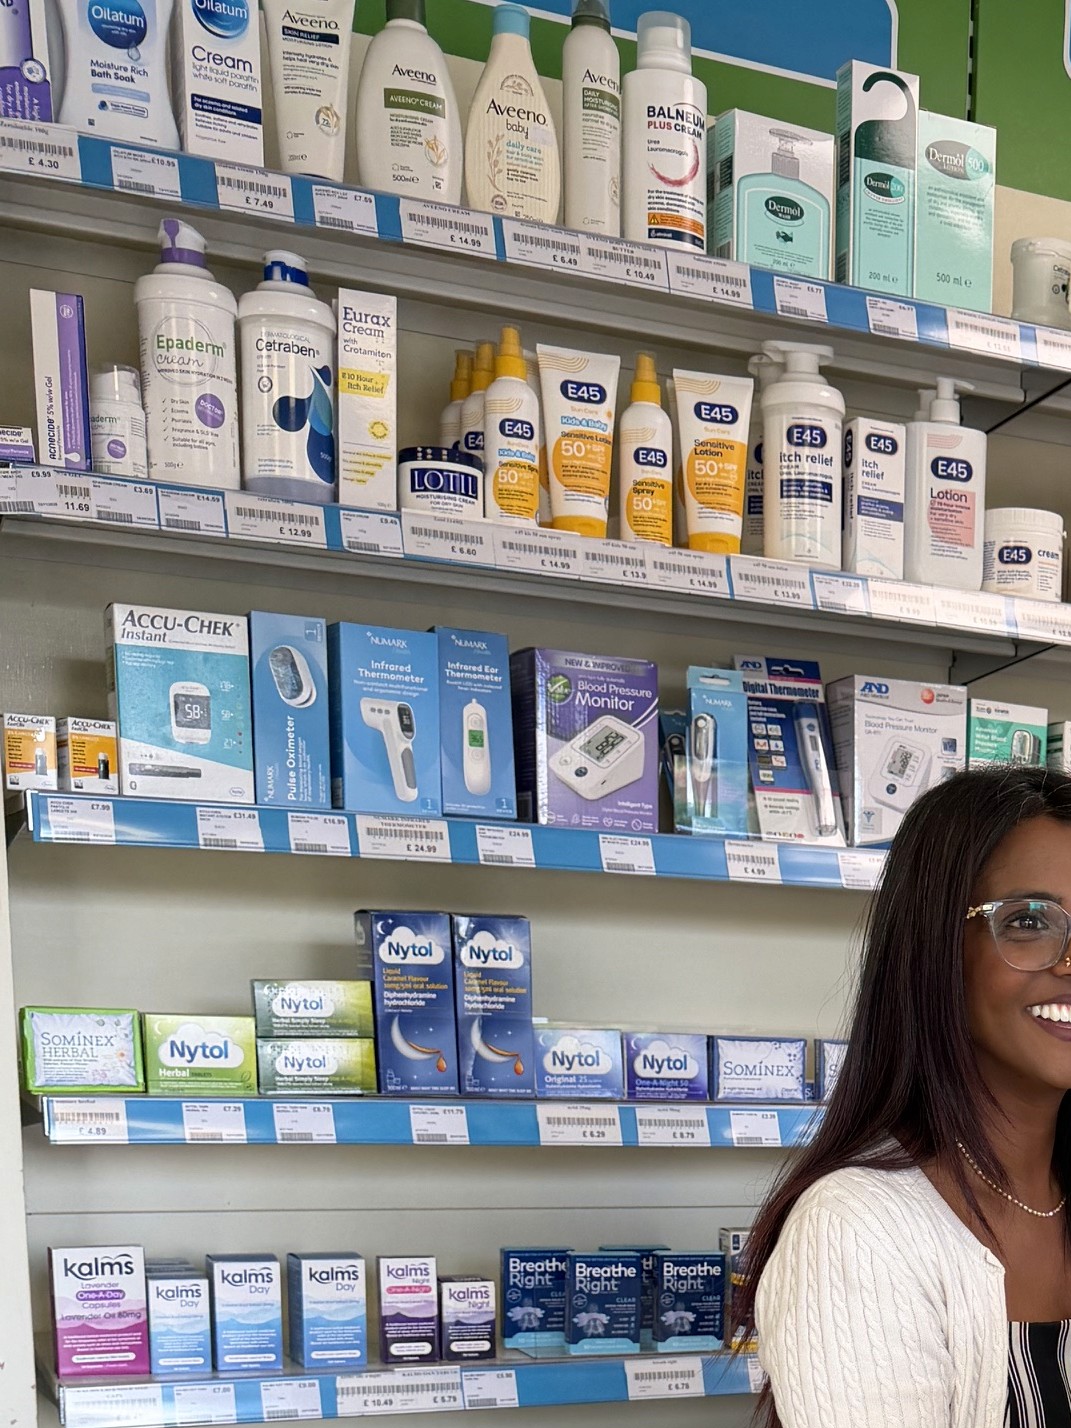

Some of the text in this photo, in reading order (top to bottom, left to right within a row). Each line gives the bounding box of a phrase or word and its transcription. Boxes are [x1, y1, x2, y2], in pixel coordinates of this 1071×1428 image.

[91, 6, 145, 29] Oilatum
[192, 46, 253, 73] Cream
[90, 59, 149, 77] Moisture Rich
[392, 64, 437, 83] Aveeno
[91, 70, 136, 84] Bath Soak
[193, 73, 212, 83] white
[231, 79, 258, 92] paraffin
[235, 71, 259, 84] paraffin
[420, 98, 442, 111] CREAM
[647, 105, 705, 129] BALNEUM
[506, 119, 529, 139] baby
[647, 120, 702, 140] PLUS CREAM
[766, 200, 801, 217] Dermol
[343, 306, 390, 327] Eurax
[343, 322, 384, 338] Cream
[344, 344, 391, 358] Crotamiton
[567, 382, 601, 401] E45
[700, 404, 733, 423] E45
[506, 422, 531, 438] E45
[793, 427, 821, 444] E45
[871, 436, 892, 452] E45
[639, 449, 665, 465] E45
[694, 448, 723, 458] Lotion
[780, 452, 833, 467] itch relief
[414, 468, 477, 493] LOTIL
[121, 628, 167, 643] Instant
[359, 668, 424, 682] Thermometer
[371, 661, 411, 673] Infrared
[447, 662, 498, 674] Infrared Ear
[446, 670, 502, 682] Thermometer
[577, 681, 652, 698] Blood Pressure
[743, 682, 819, 698] Digital Thermometer
[575, 693, 634, 711] Monitor
[8, 716, 50, 725] ACCU-CHEK
[287, 716, 295, 800] Pulse Oximeter
[470, 945, 512, 963] Nytol
[281, 997, 323, 1014] Nytol
[42, 1046, 98, 1058] HERBAL
[170, 1039, 229, 1062] Nytol
[284, 1054, 326, 1071] Nytol
[552, 1051, 600, 1069] Nytol
[643, 1055, 687, 1072] Nytol
[159, 1069, 189, 1078] Herbal
[64, 1254, 134, 1280] kalms
[309, 1266, 359, 1283] kalms
[575, 1264, 636, 1279] Breathe
[663, 1263, 722, 1276] Breathe
[221, 1268, 273, 1286] kalms
[663, 1275, 706, 1291] Right
[156, 1284, 201, 1300] kalms
[575, 1278, 619, 1293] Right
[448, 1287, 489, 1301] kalms
[180, 1300, 199, 1309] Day
